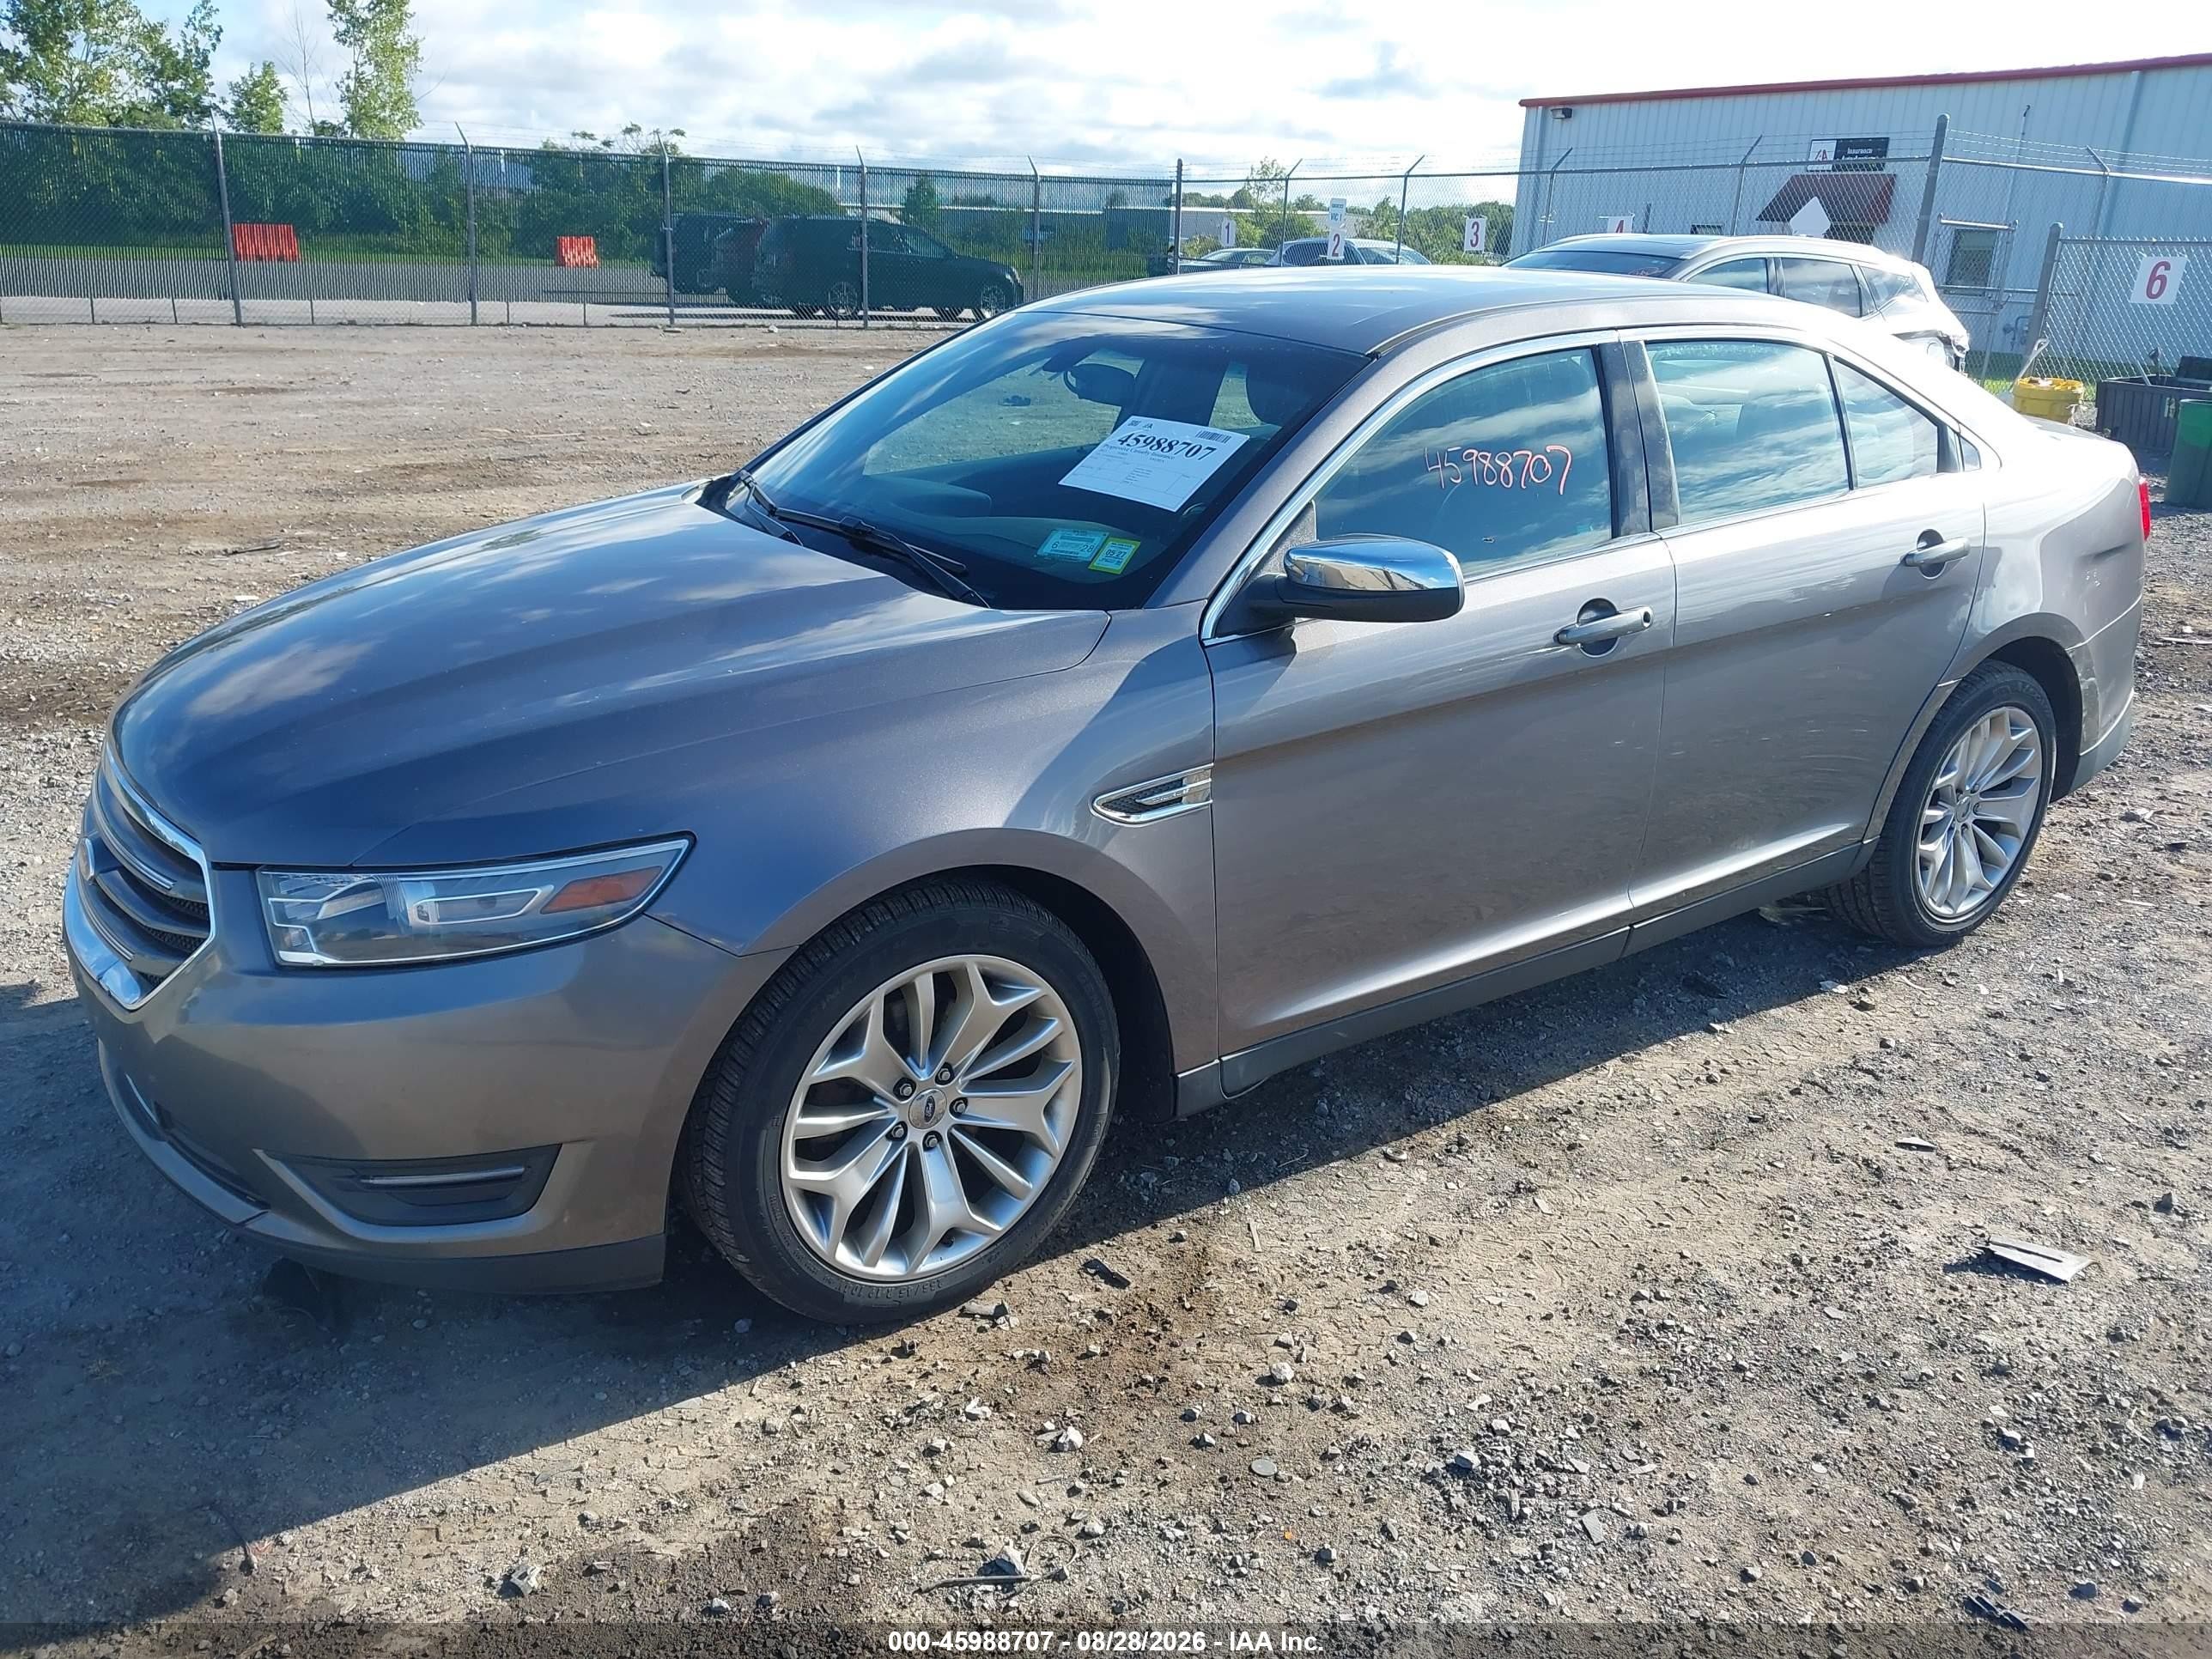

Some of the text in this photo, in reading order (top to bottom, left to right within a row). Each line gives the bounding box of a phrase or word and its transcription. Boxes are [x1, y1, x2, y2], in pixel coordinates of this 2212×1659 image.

[1224, 222, 1231, 245] 1
[1332, 233, 1340, 257] 2
[1470, 221, 1480, 248] 3
[2147, 260, 2172, 300] 6
[1118, 433, 1217, 461] 45988707
[1425, 445, 1572, 495] 45988707
